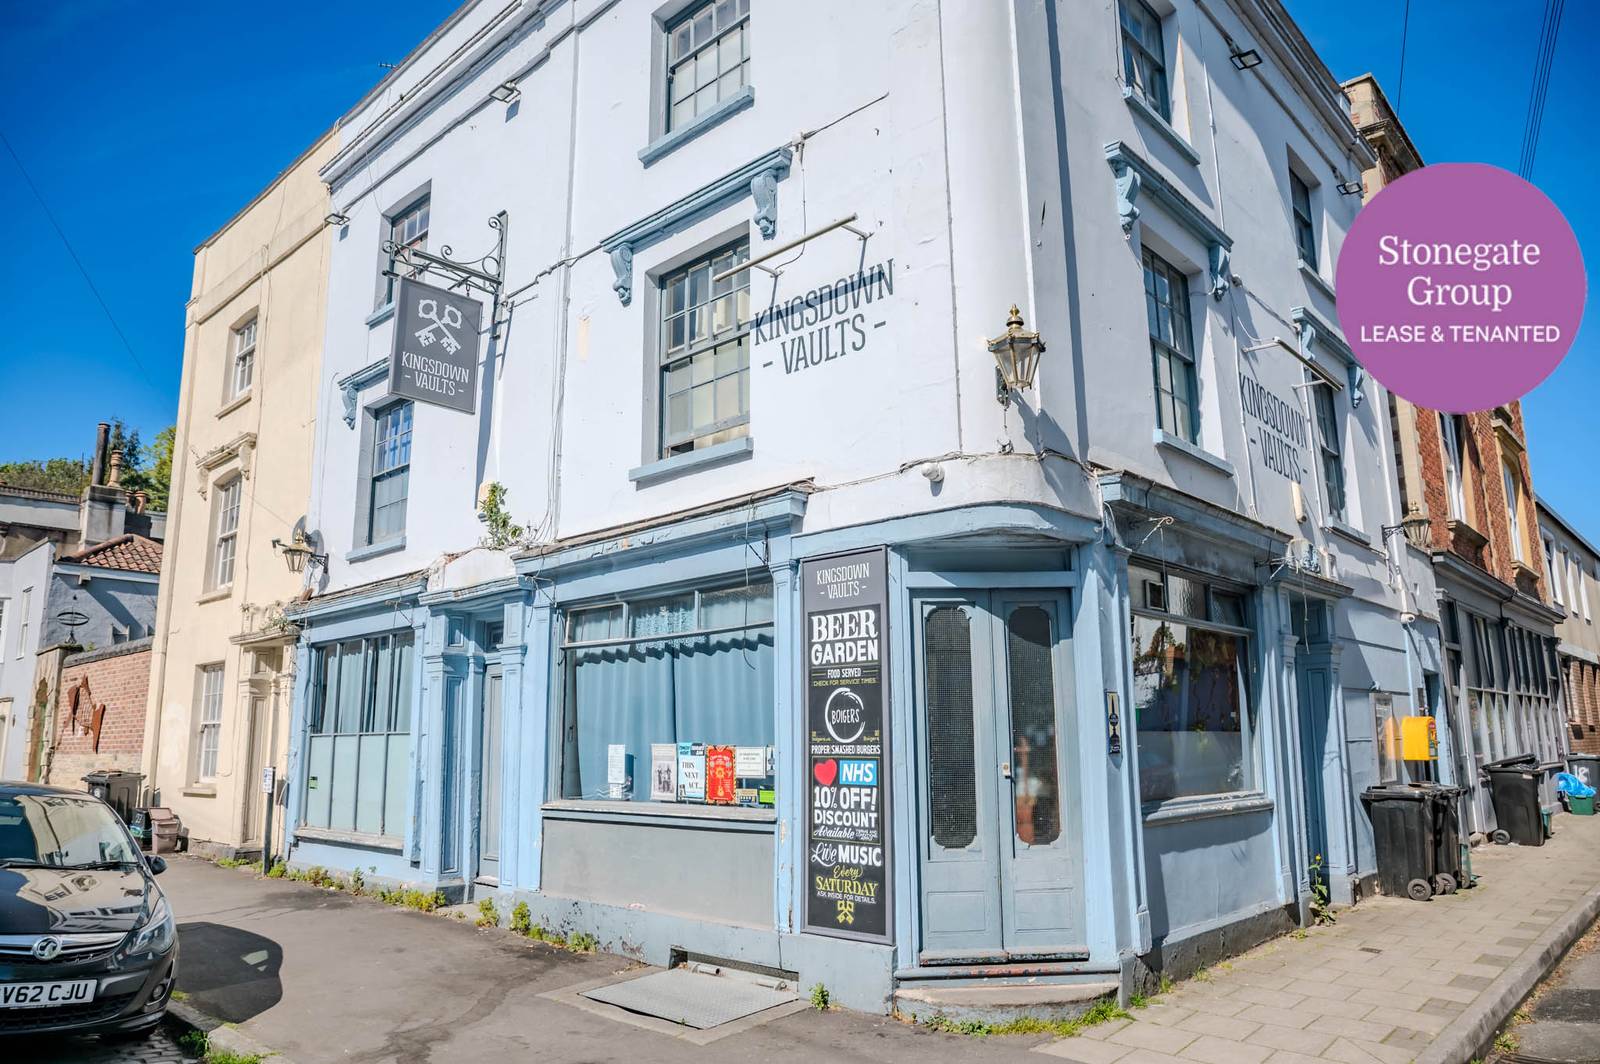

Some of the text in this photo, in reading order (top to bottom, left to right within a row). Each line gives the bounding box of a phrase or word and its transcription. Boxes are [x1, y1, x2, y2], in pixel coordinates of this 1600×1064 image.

[754, 258, 894, 346] KINGSDOWN
[781, 313, 866, 375] VAULTS
[401, 351, 470, 384] KINGSDOWN
[414, 371, 456, 396] VAULTS
[1239, 372, 1308, 450] KINGSDOWN
[1258, 426, 1301, 484] VAULTS
[816, 562, 870, 585] KINGSDOWN
[827, 580, 860, 599] VAULTS
[811, 609, 879, 643] BEER
[811, 639, 879, 665] GARDEN
[827, 668, 861, 678] FOOD SERVED
[831, 709, 860, 725] BOIGERS
[811, 744, 880, 754] PROPER SMASHED BURGERS
[842, 763, 873, 783] NHS
[814, 786, 877, 811] 10% OFF!
[814, 809, 878, 828] DISCOUNT
[813, 825, 855, 839] Available
[811, 842, 882, 867] Live MUSIC
[833, 864, 863, 880] Every
[815, 876, 878, 897] SATURDAY
[827, 891, 842, 899] INSIDE
[843, 893, 854, 901] FOR
[0, 983, 88, 1004] V62 CJU
